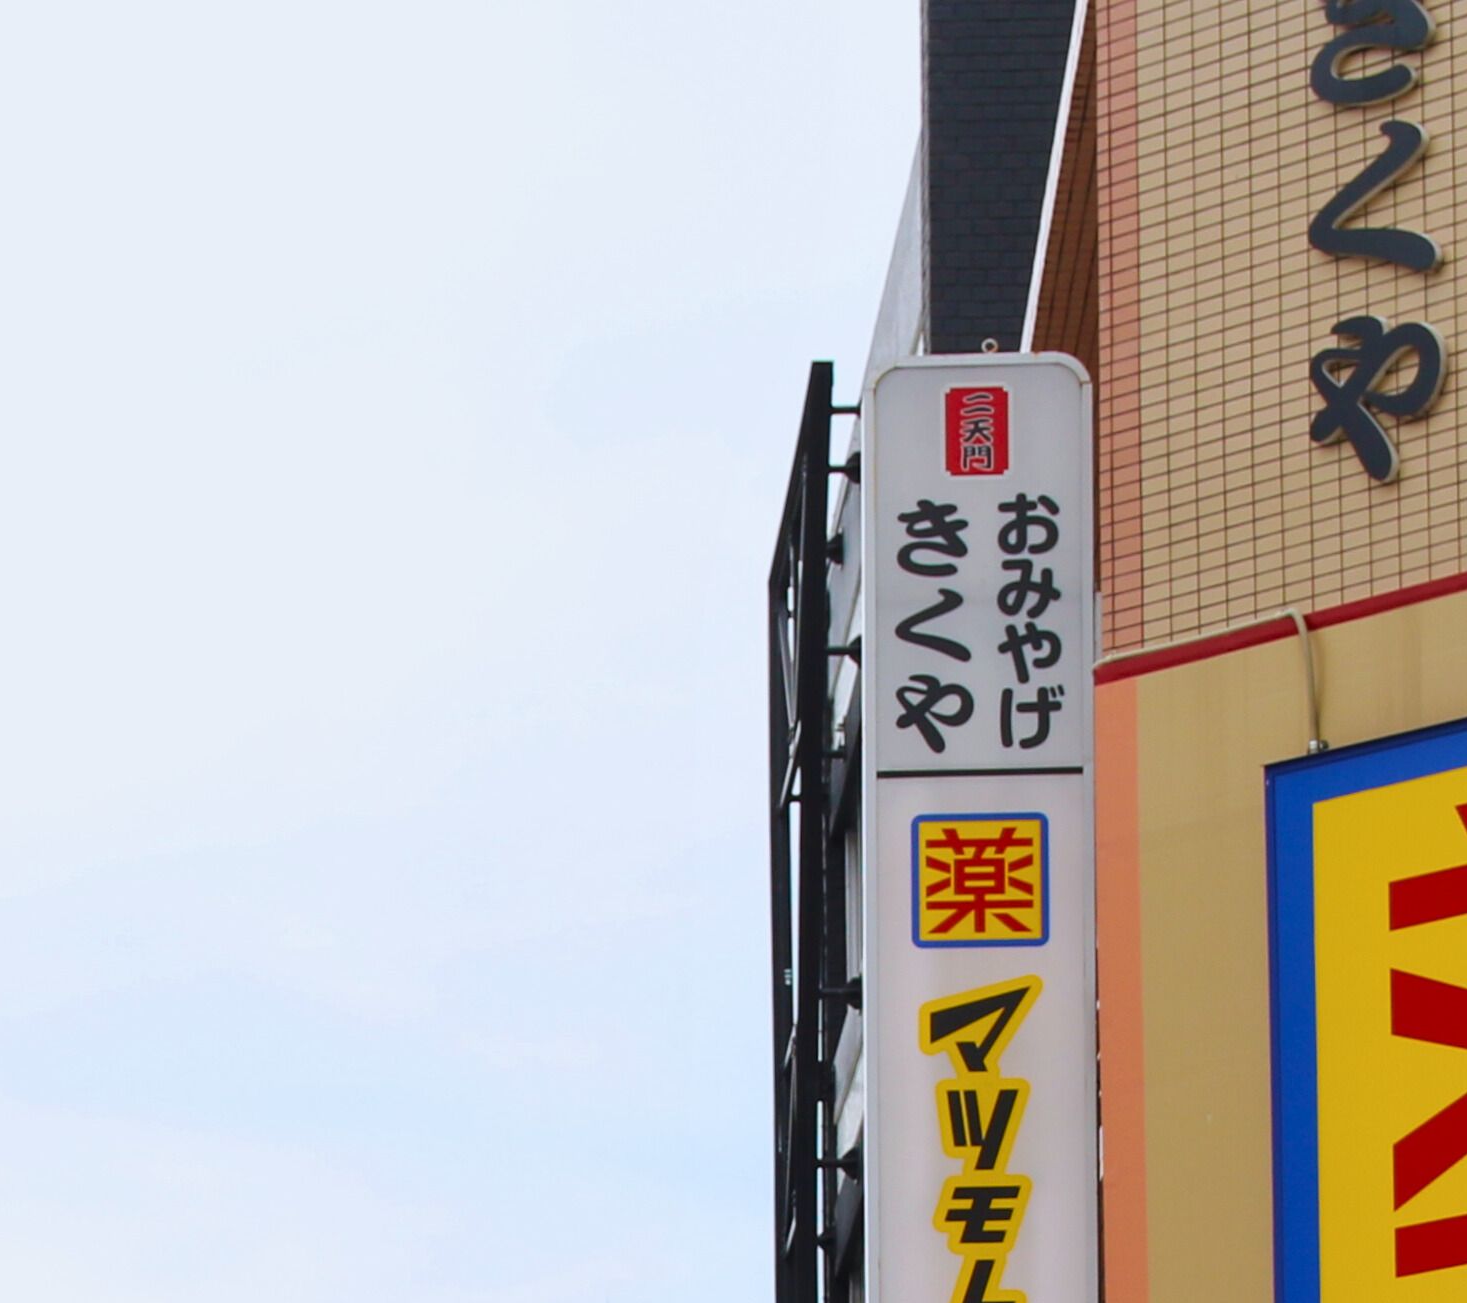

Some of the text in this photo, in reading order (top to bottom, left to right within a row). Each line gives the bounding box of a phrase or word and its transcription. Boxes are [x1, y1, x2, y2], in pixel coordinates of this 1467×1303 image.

[961, 391, 994, 471] 二天門
[895, 499, 975, 754] きくや
[998, 492, 1065, 750] おみやげ
[925, 827, 1035, 935] 薬
